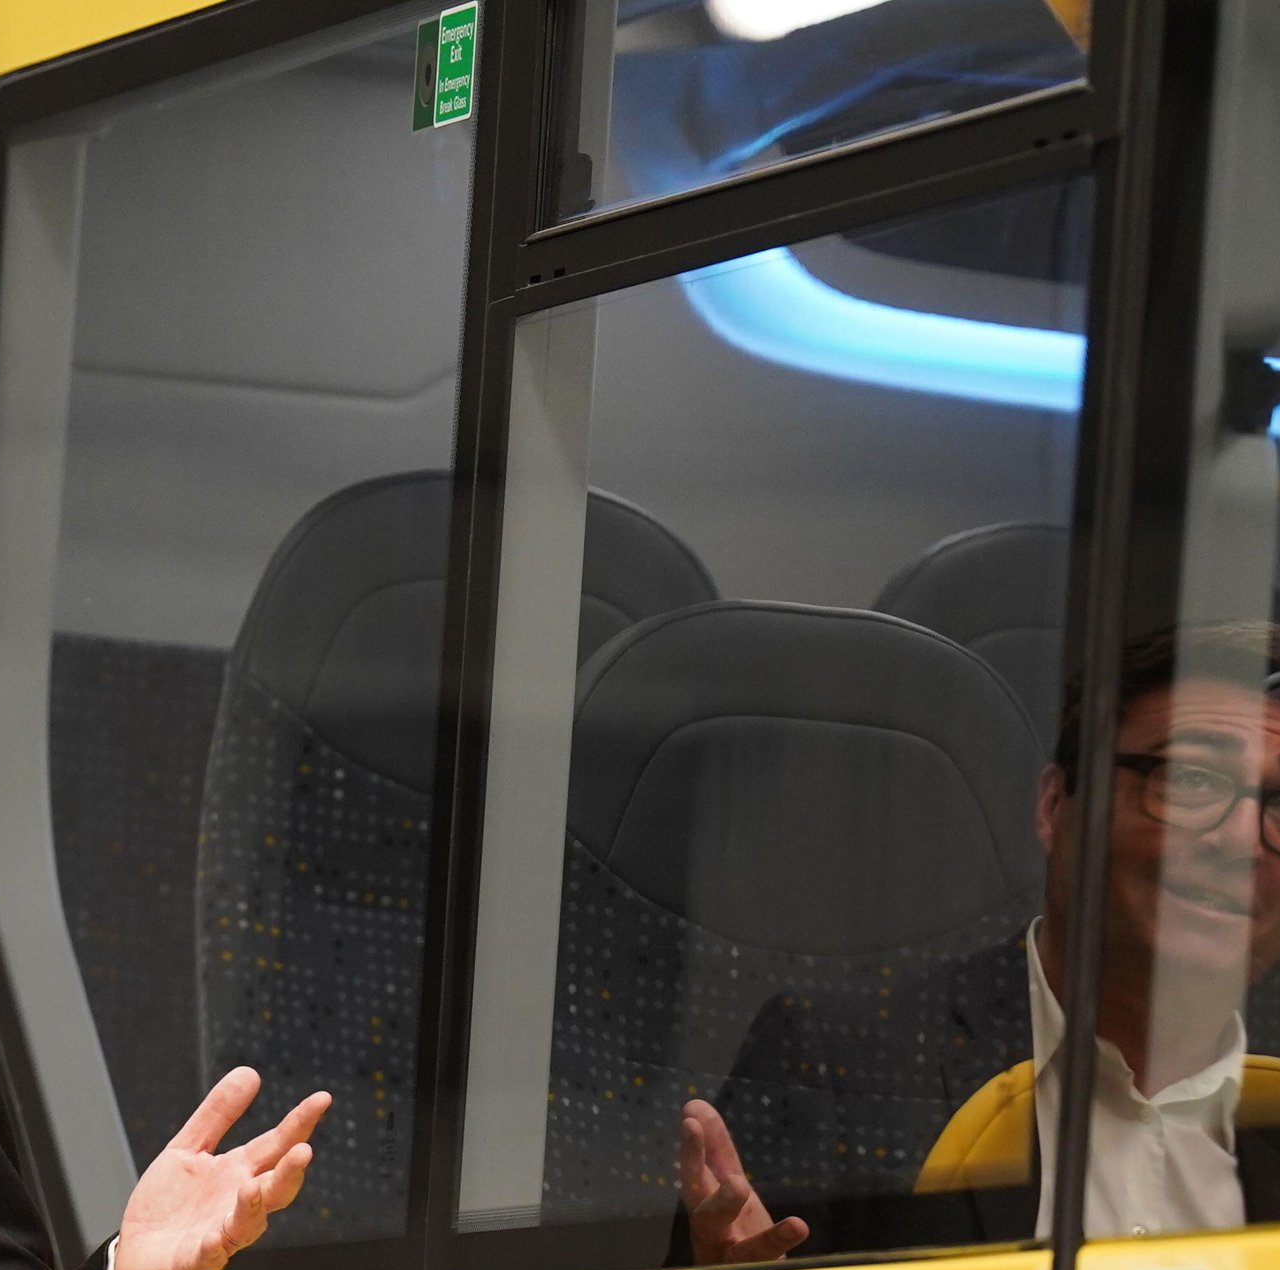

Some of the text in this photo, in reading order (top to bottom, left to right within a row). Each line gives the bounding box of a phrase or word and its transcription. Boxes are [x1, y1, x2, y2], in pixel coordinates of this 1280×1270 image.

[442, 22, 474, 44] Emergency
[450, 44, 462, 63] Exit
[439, 74, 470, 93] In Emergency
[440, 96, 467, 114] Break Glass
